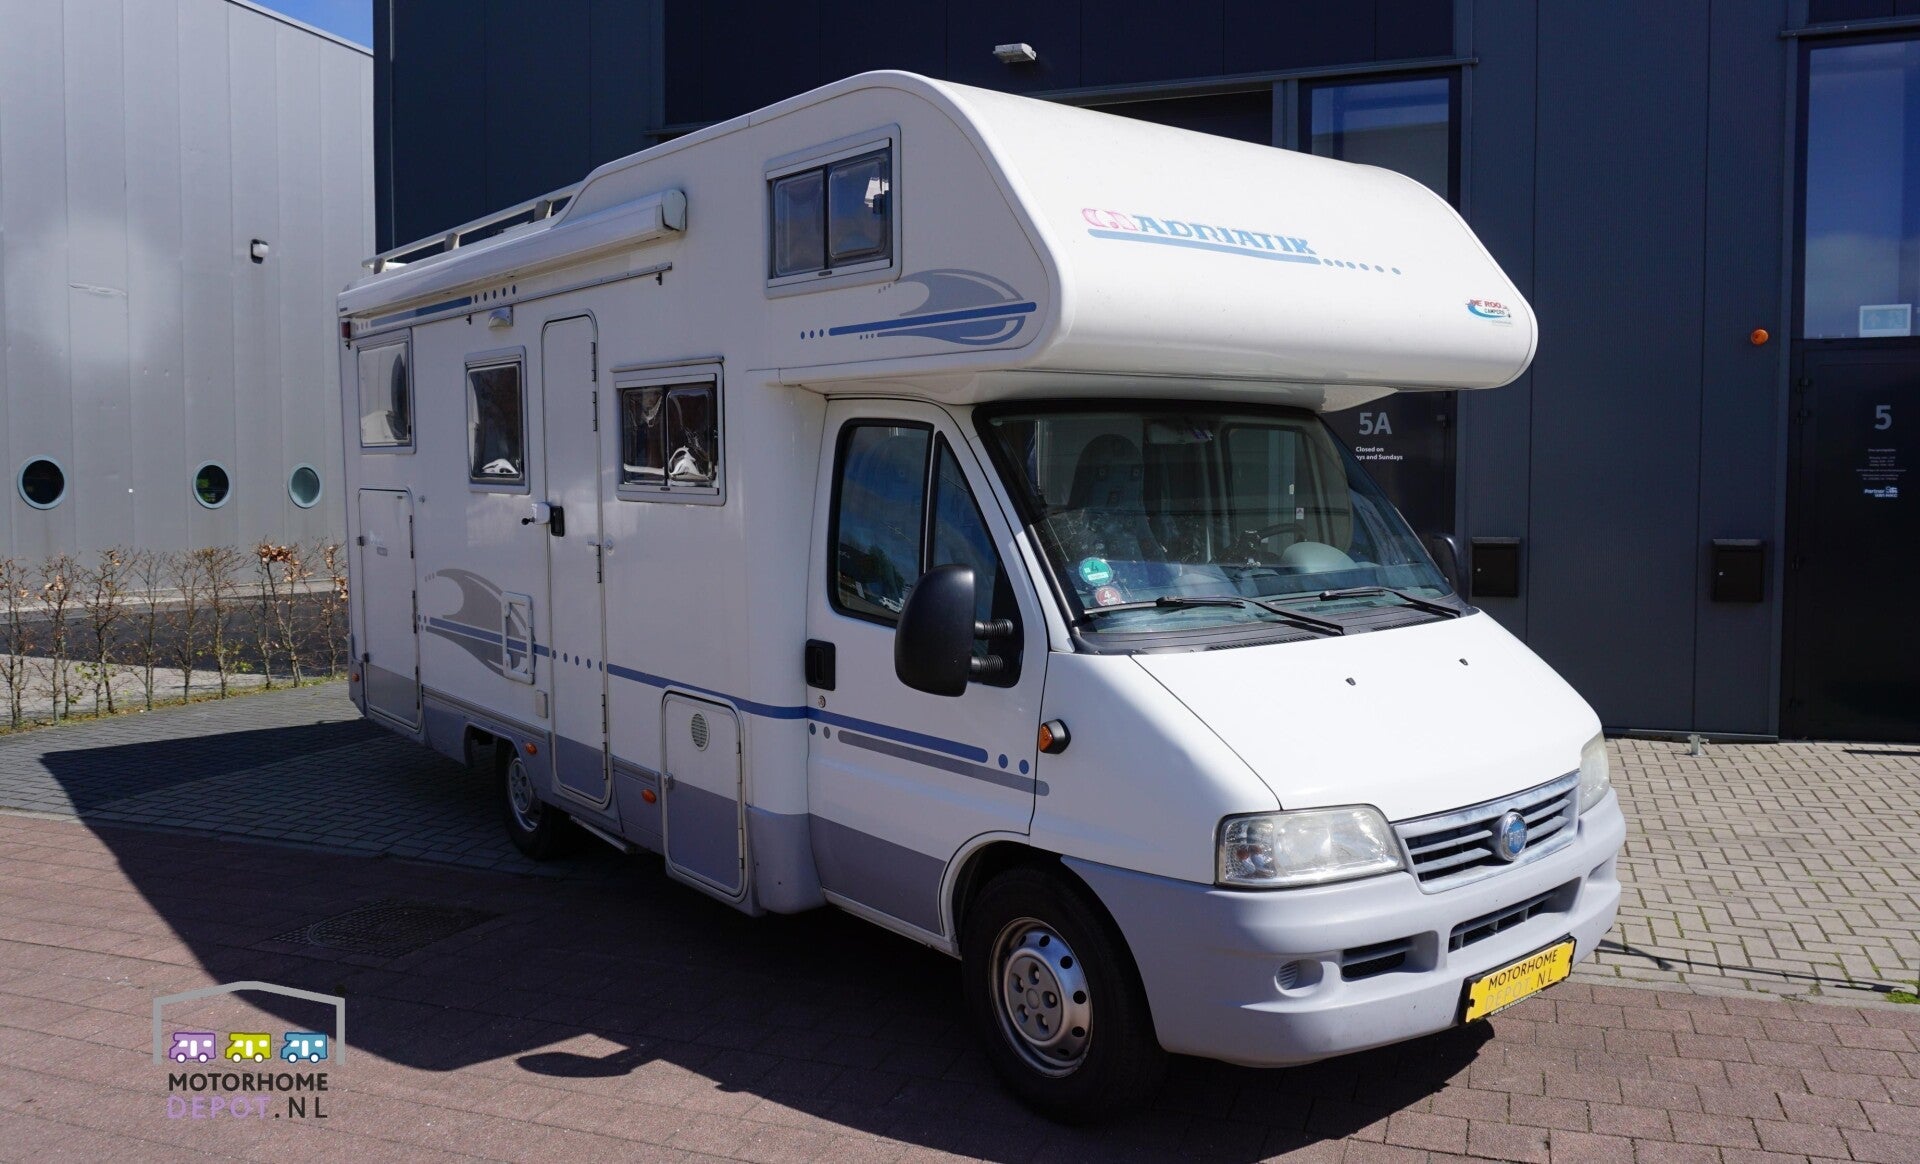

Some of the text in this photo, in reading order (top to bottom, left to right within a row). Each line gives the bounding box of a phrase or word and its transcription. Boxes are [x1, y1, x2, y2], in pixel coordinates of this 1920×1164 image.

[1131, 213, 1317, 255] ADRIATIK
[1358, 411, 1393, 435] 5A
[1874, 404, 1892, 430] 5
[1378, 453, 1403, 462] Sundays
[1488, 949, 1558, 991] MOTORHOME
